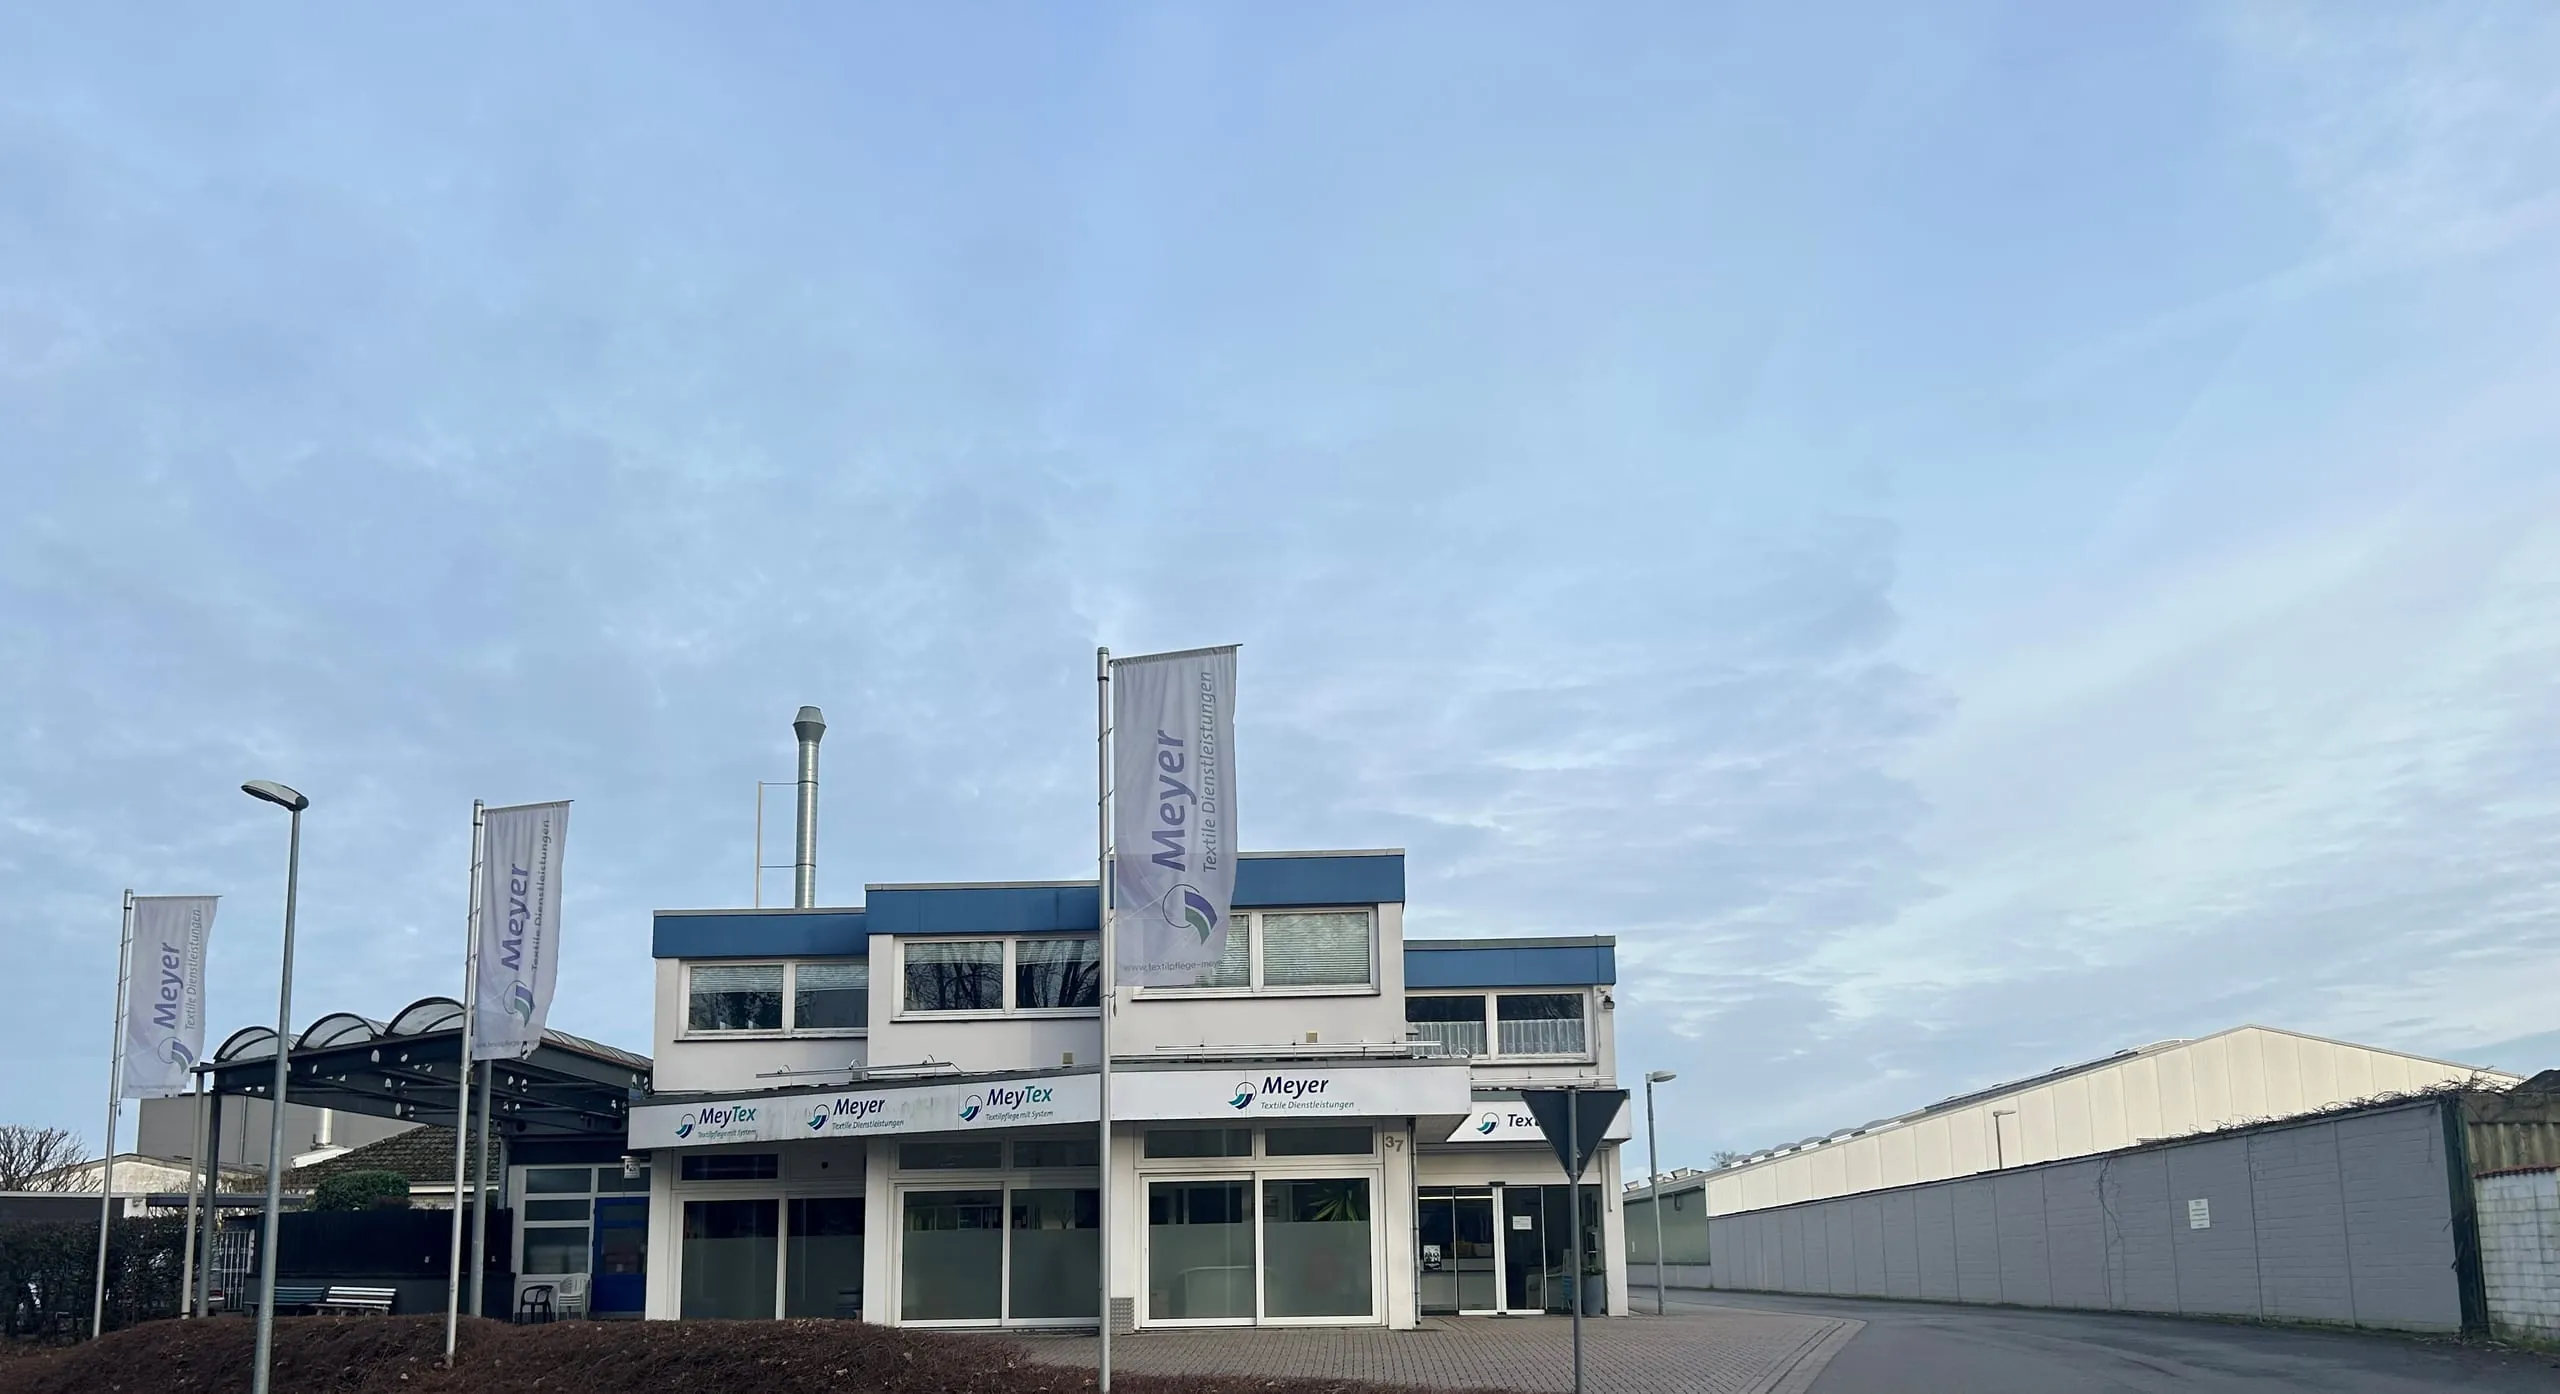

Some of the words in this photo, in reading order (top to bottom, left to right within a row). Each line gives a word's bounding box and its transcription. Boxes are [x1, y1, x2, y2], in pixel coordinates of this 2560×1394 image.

[1199, 671, 1216, 814] Dienstleistungen
[1151, 729, 1197, 872] Meyer
[1201, 818, 1217, 872] Textile
[501, 863, 531, 971] Meyer
[187, 909, 201, 994] Dienstleistungen
[153, 942, 184, 1030] Meyer
[185, 994, 199, 1031] Textile
[986, 1085, 1053, 1110] MeyTex
[1262, 1076, 1329, 1100] Meyer
[698, 1105, 757, 1129] MeyTex
[833, 1098, 886, 1119] Meyer
[1261, 1101, 1287, 1110] Textile
[1288, 1101, 1354, 1111] Dienstleistungen
[832, 1121, 852, 1130] Textile
[853, 1119, 905, 1129] Dienstleistungen
[1385, 1135, 1404, 1152] 37
